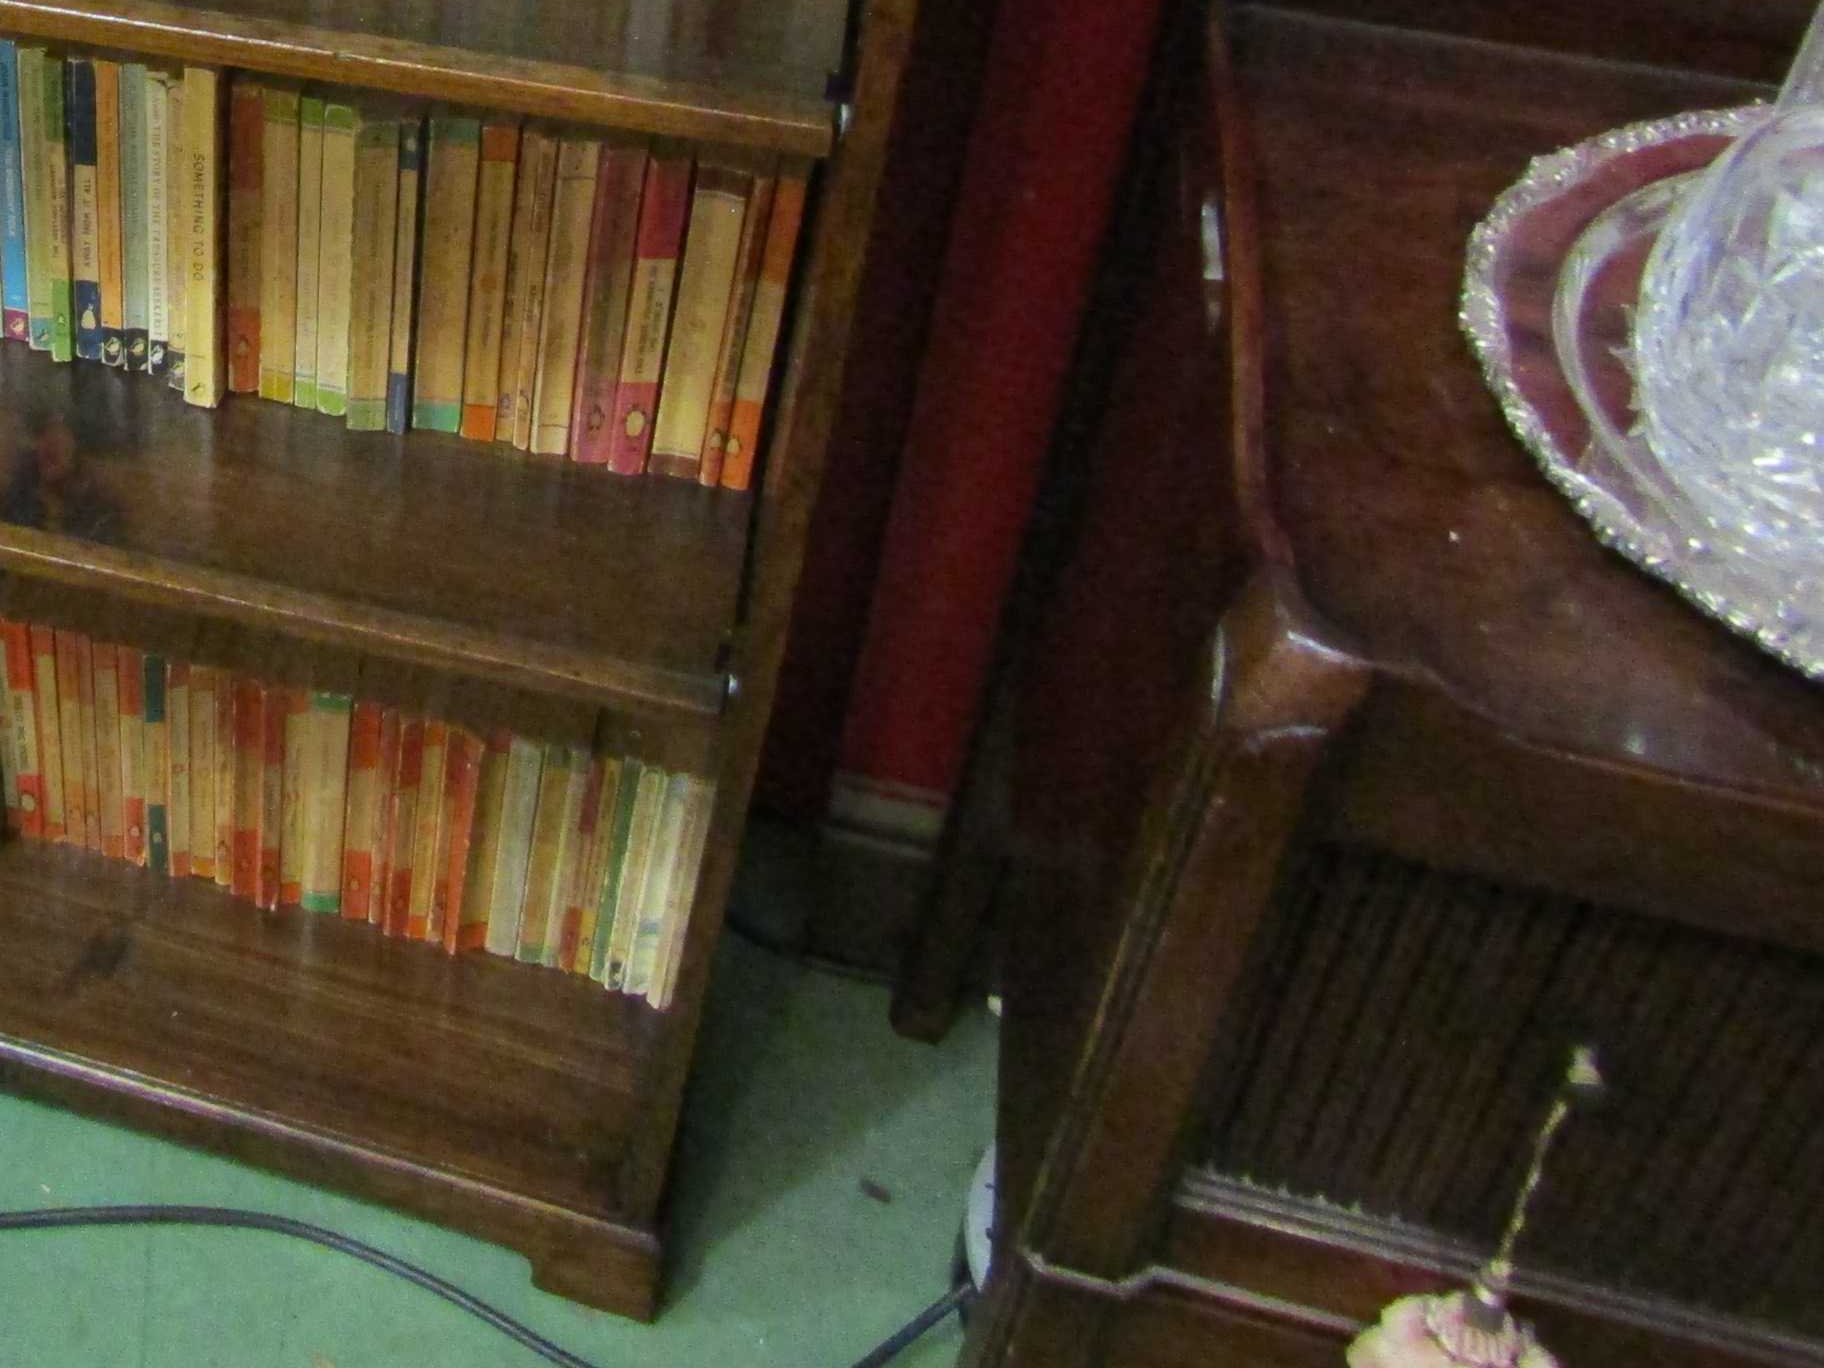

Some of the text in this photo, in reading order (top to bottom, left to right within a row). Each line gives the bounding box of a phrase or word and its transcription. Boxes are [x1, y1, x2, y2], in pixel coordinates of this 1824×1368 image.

[192, 153, 205, 280] SOMETHING TO DO
